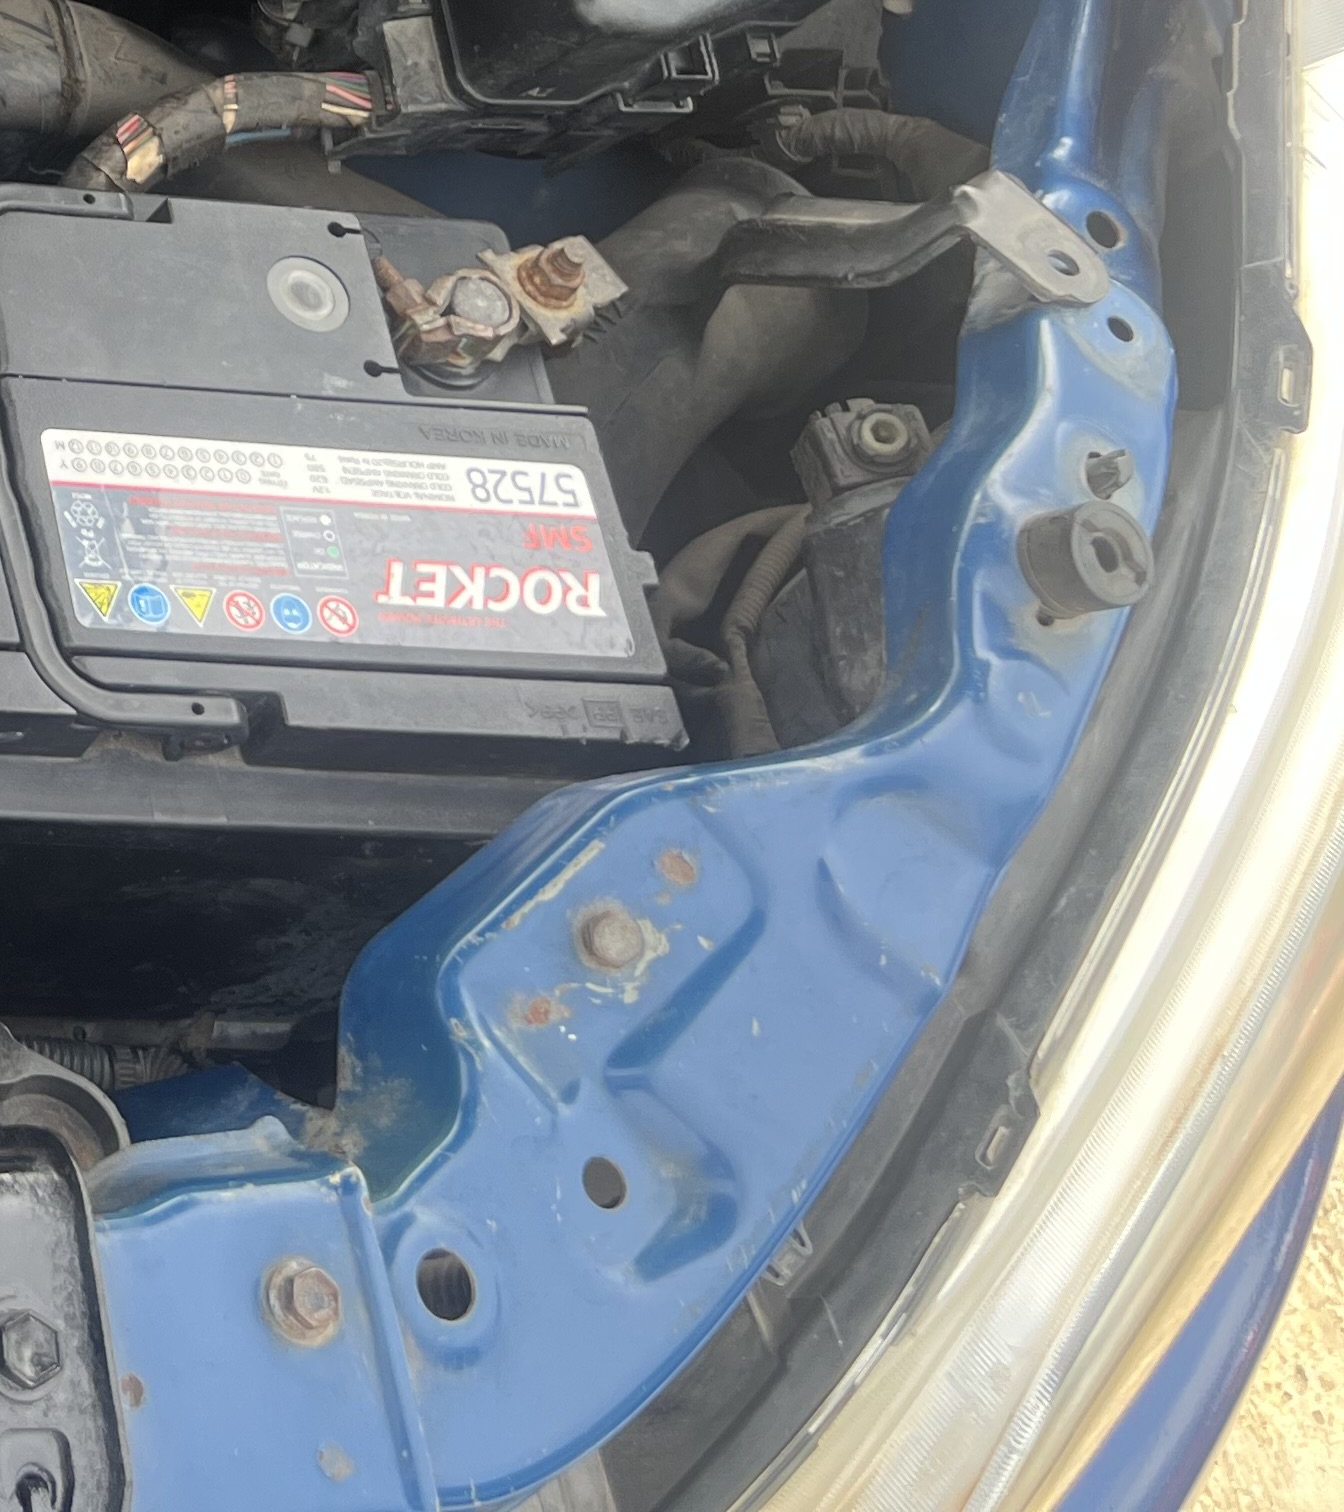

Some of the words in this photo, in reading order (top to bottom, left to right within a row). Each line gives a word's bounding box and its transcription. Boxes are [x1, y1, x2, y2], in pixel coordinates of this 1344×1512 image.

[55, 441, 64, 450] M
[417, 426, 485, 446] KOREA
[492, 431, 509, 446] IN
[515, 432, 571, 450] MADE
[60, 460, 68, 469] Y
[466, 468, 580, 508] 57528
[521, 524, 594, 553] SMF
[374, 560, 608, 618] ROCKET
